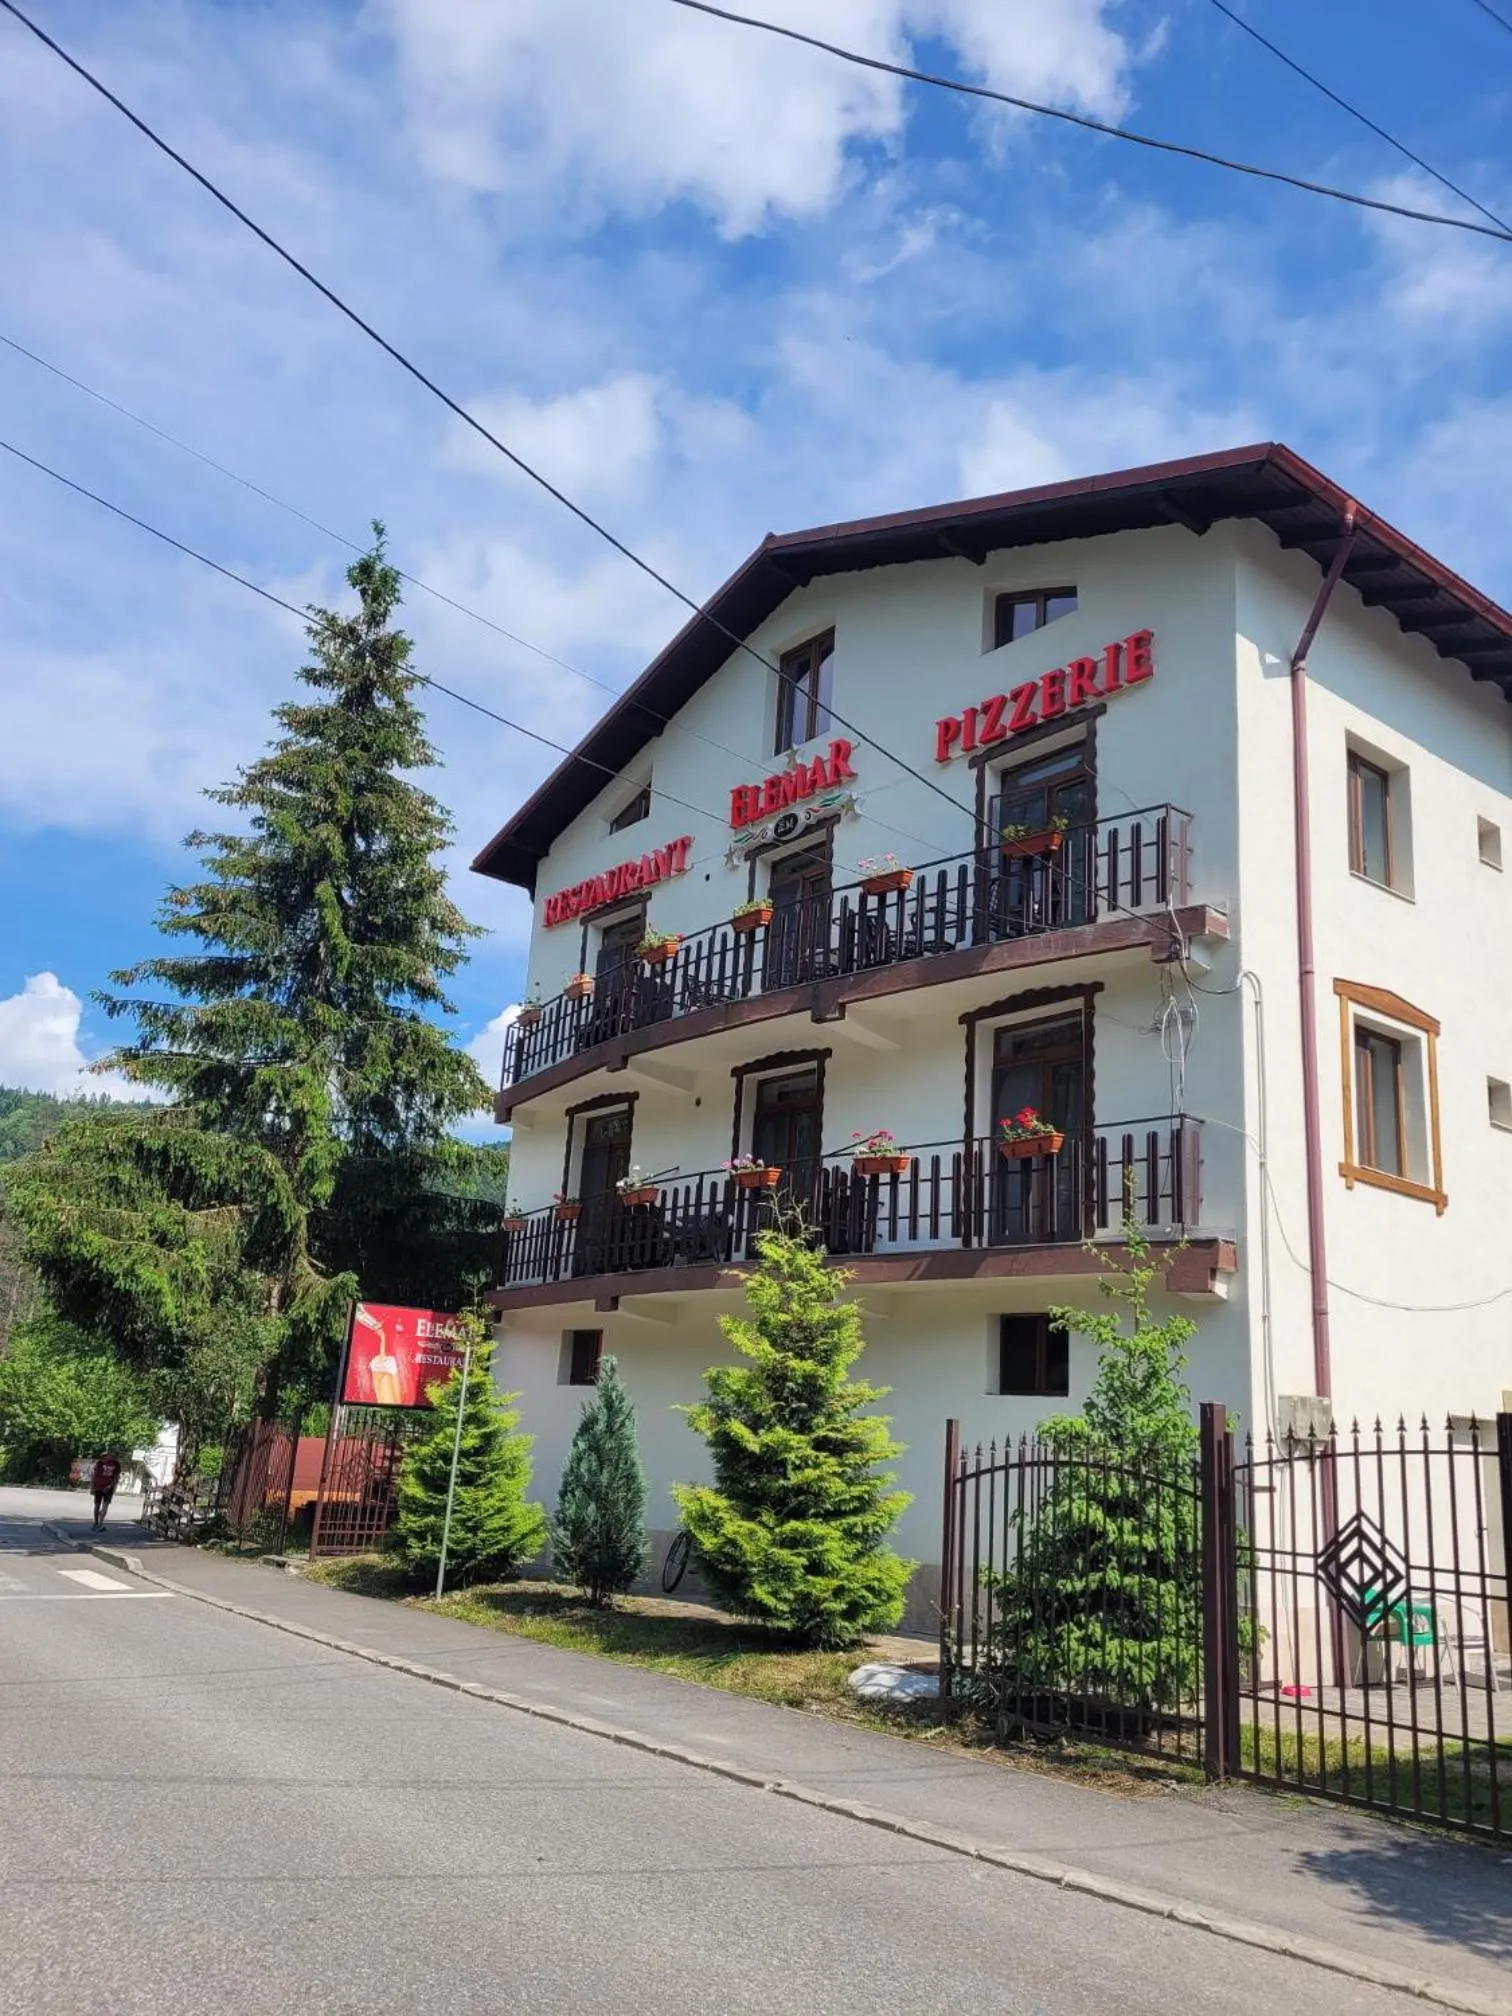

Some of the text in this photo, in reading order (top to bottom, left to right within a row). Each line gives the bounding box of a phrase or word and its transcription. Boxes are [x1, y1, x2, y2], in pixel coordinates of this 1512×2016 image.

[935, 628, 1154, 763] PIZZERIE
[730, 738, 858, 830] ELEMAR
[543, 835, 692, 928] RESTAURANT
